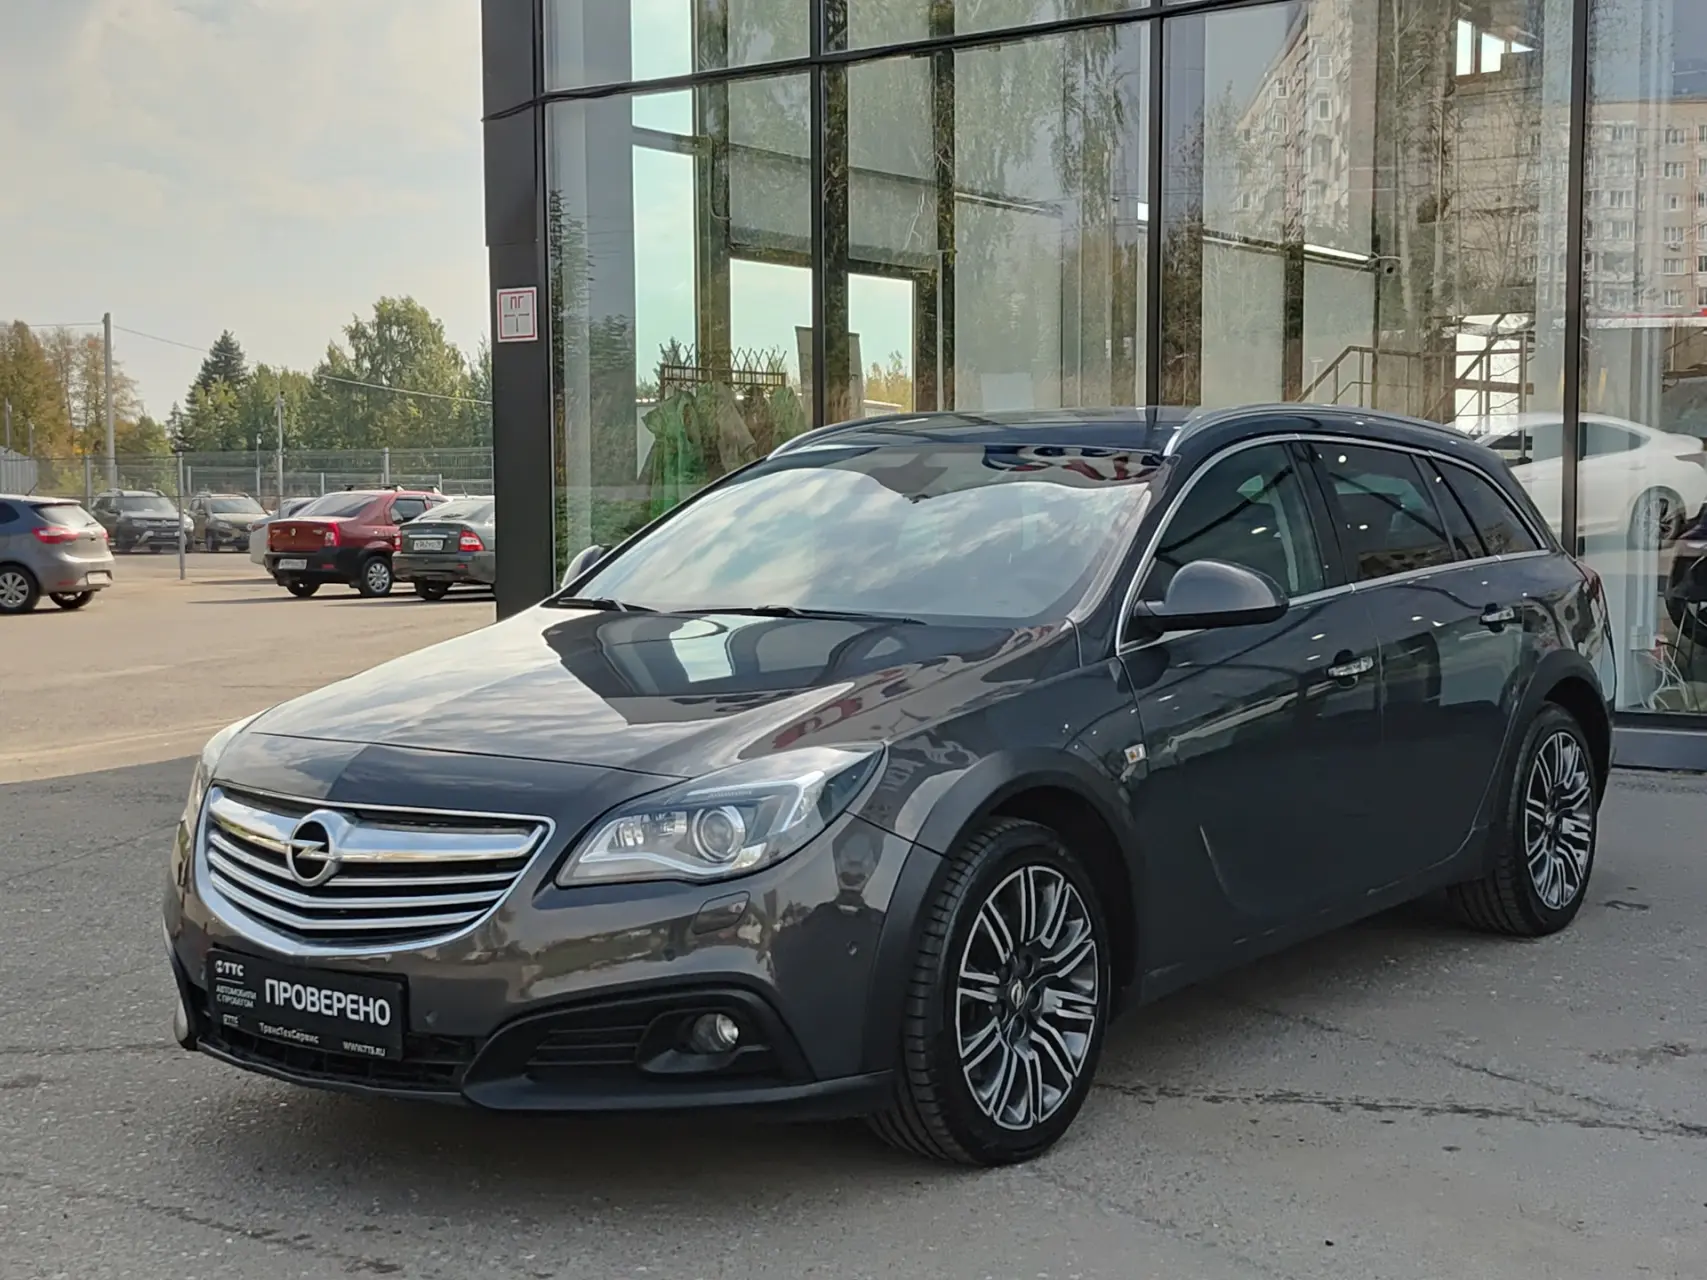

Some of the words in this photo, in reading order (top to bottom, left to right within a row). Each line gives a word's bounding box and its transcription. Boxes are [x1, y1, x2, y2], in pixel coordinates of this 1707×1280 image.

[510, 295, 524, 310] ПГ
[265, 978, 391, 1026] ПРОВЕРЕНО
[258, 1022, 320, 1044] ТрансТехСервис
